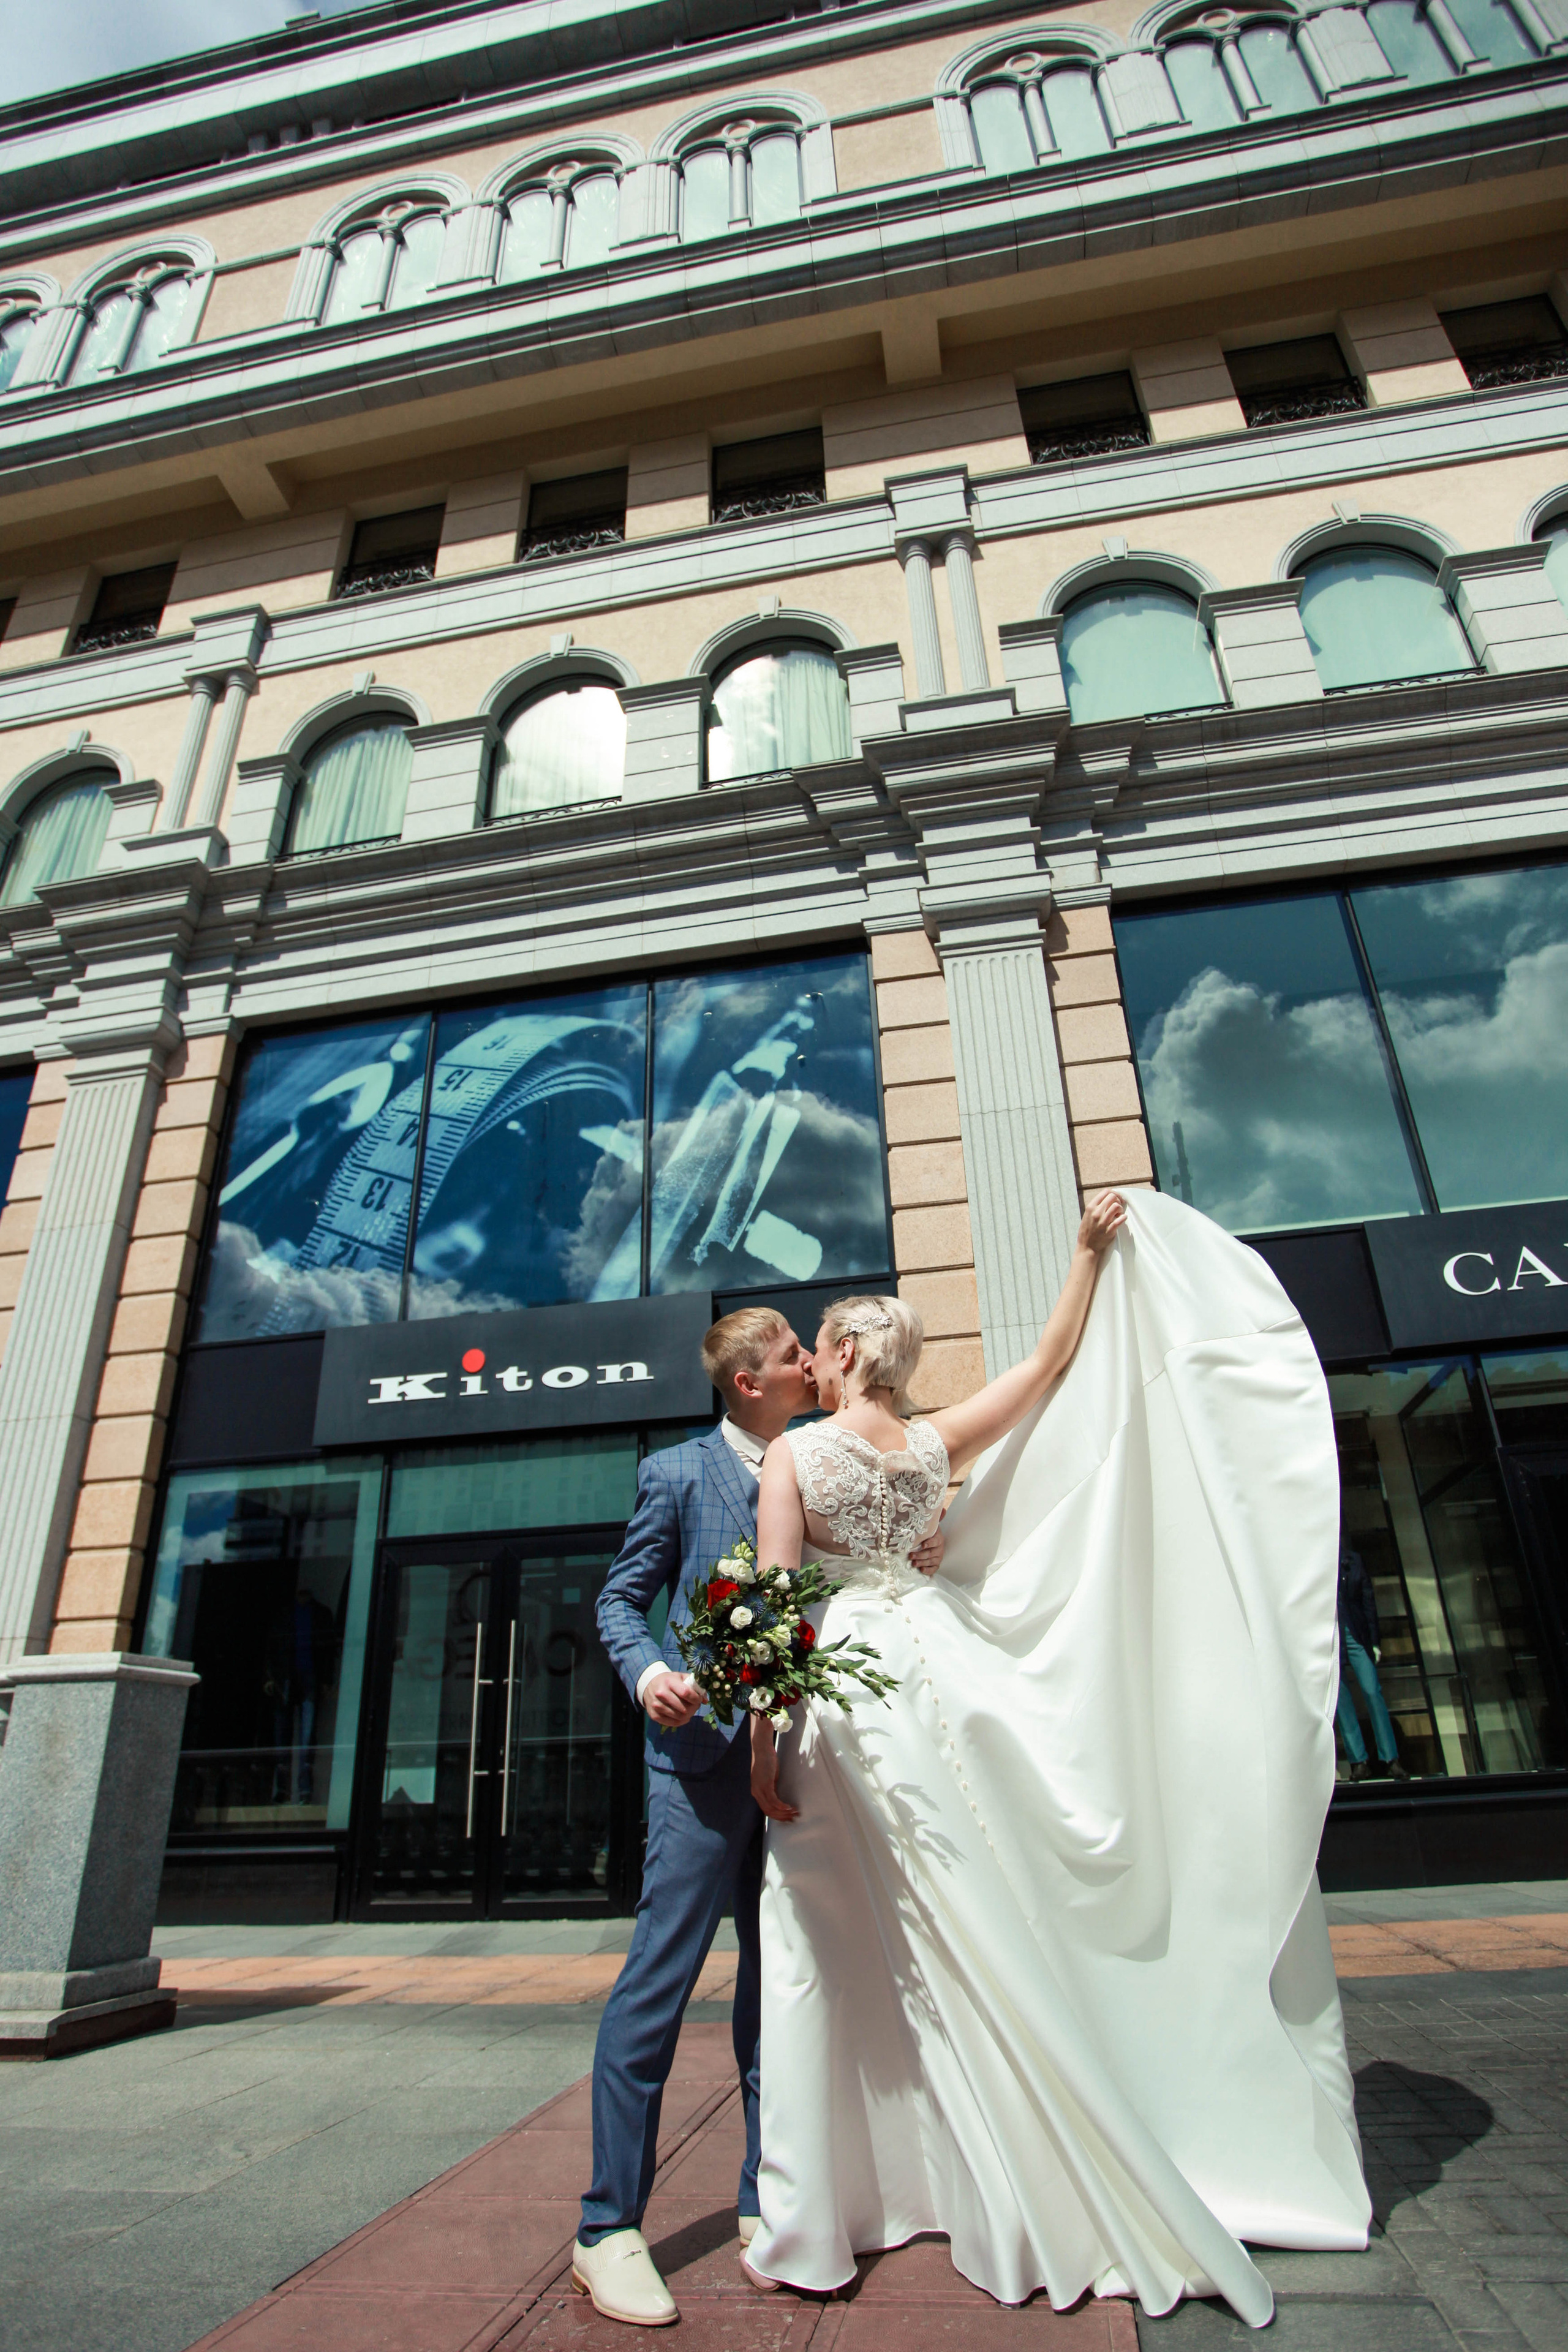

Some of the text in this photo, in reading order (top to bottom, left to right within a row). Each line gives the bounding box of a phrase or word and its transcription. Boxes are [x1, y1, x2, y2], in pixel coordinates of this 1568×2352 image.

[437, 1069, 473, 1092] 15
[396, 1118, 429, 1148] 4
[360, 1177, 394, 1212] 13
[1443, 1243, 1568, 1296] CA
[368, 1348, 655, 1404] Kiton
